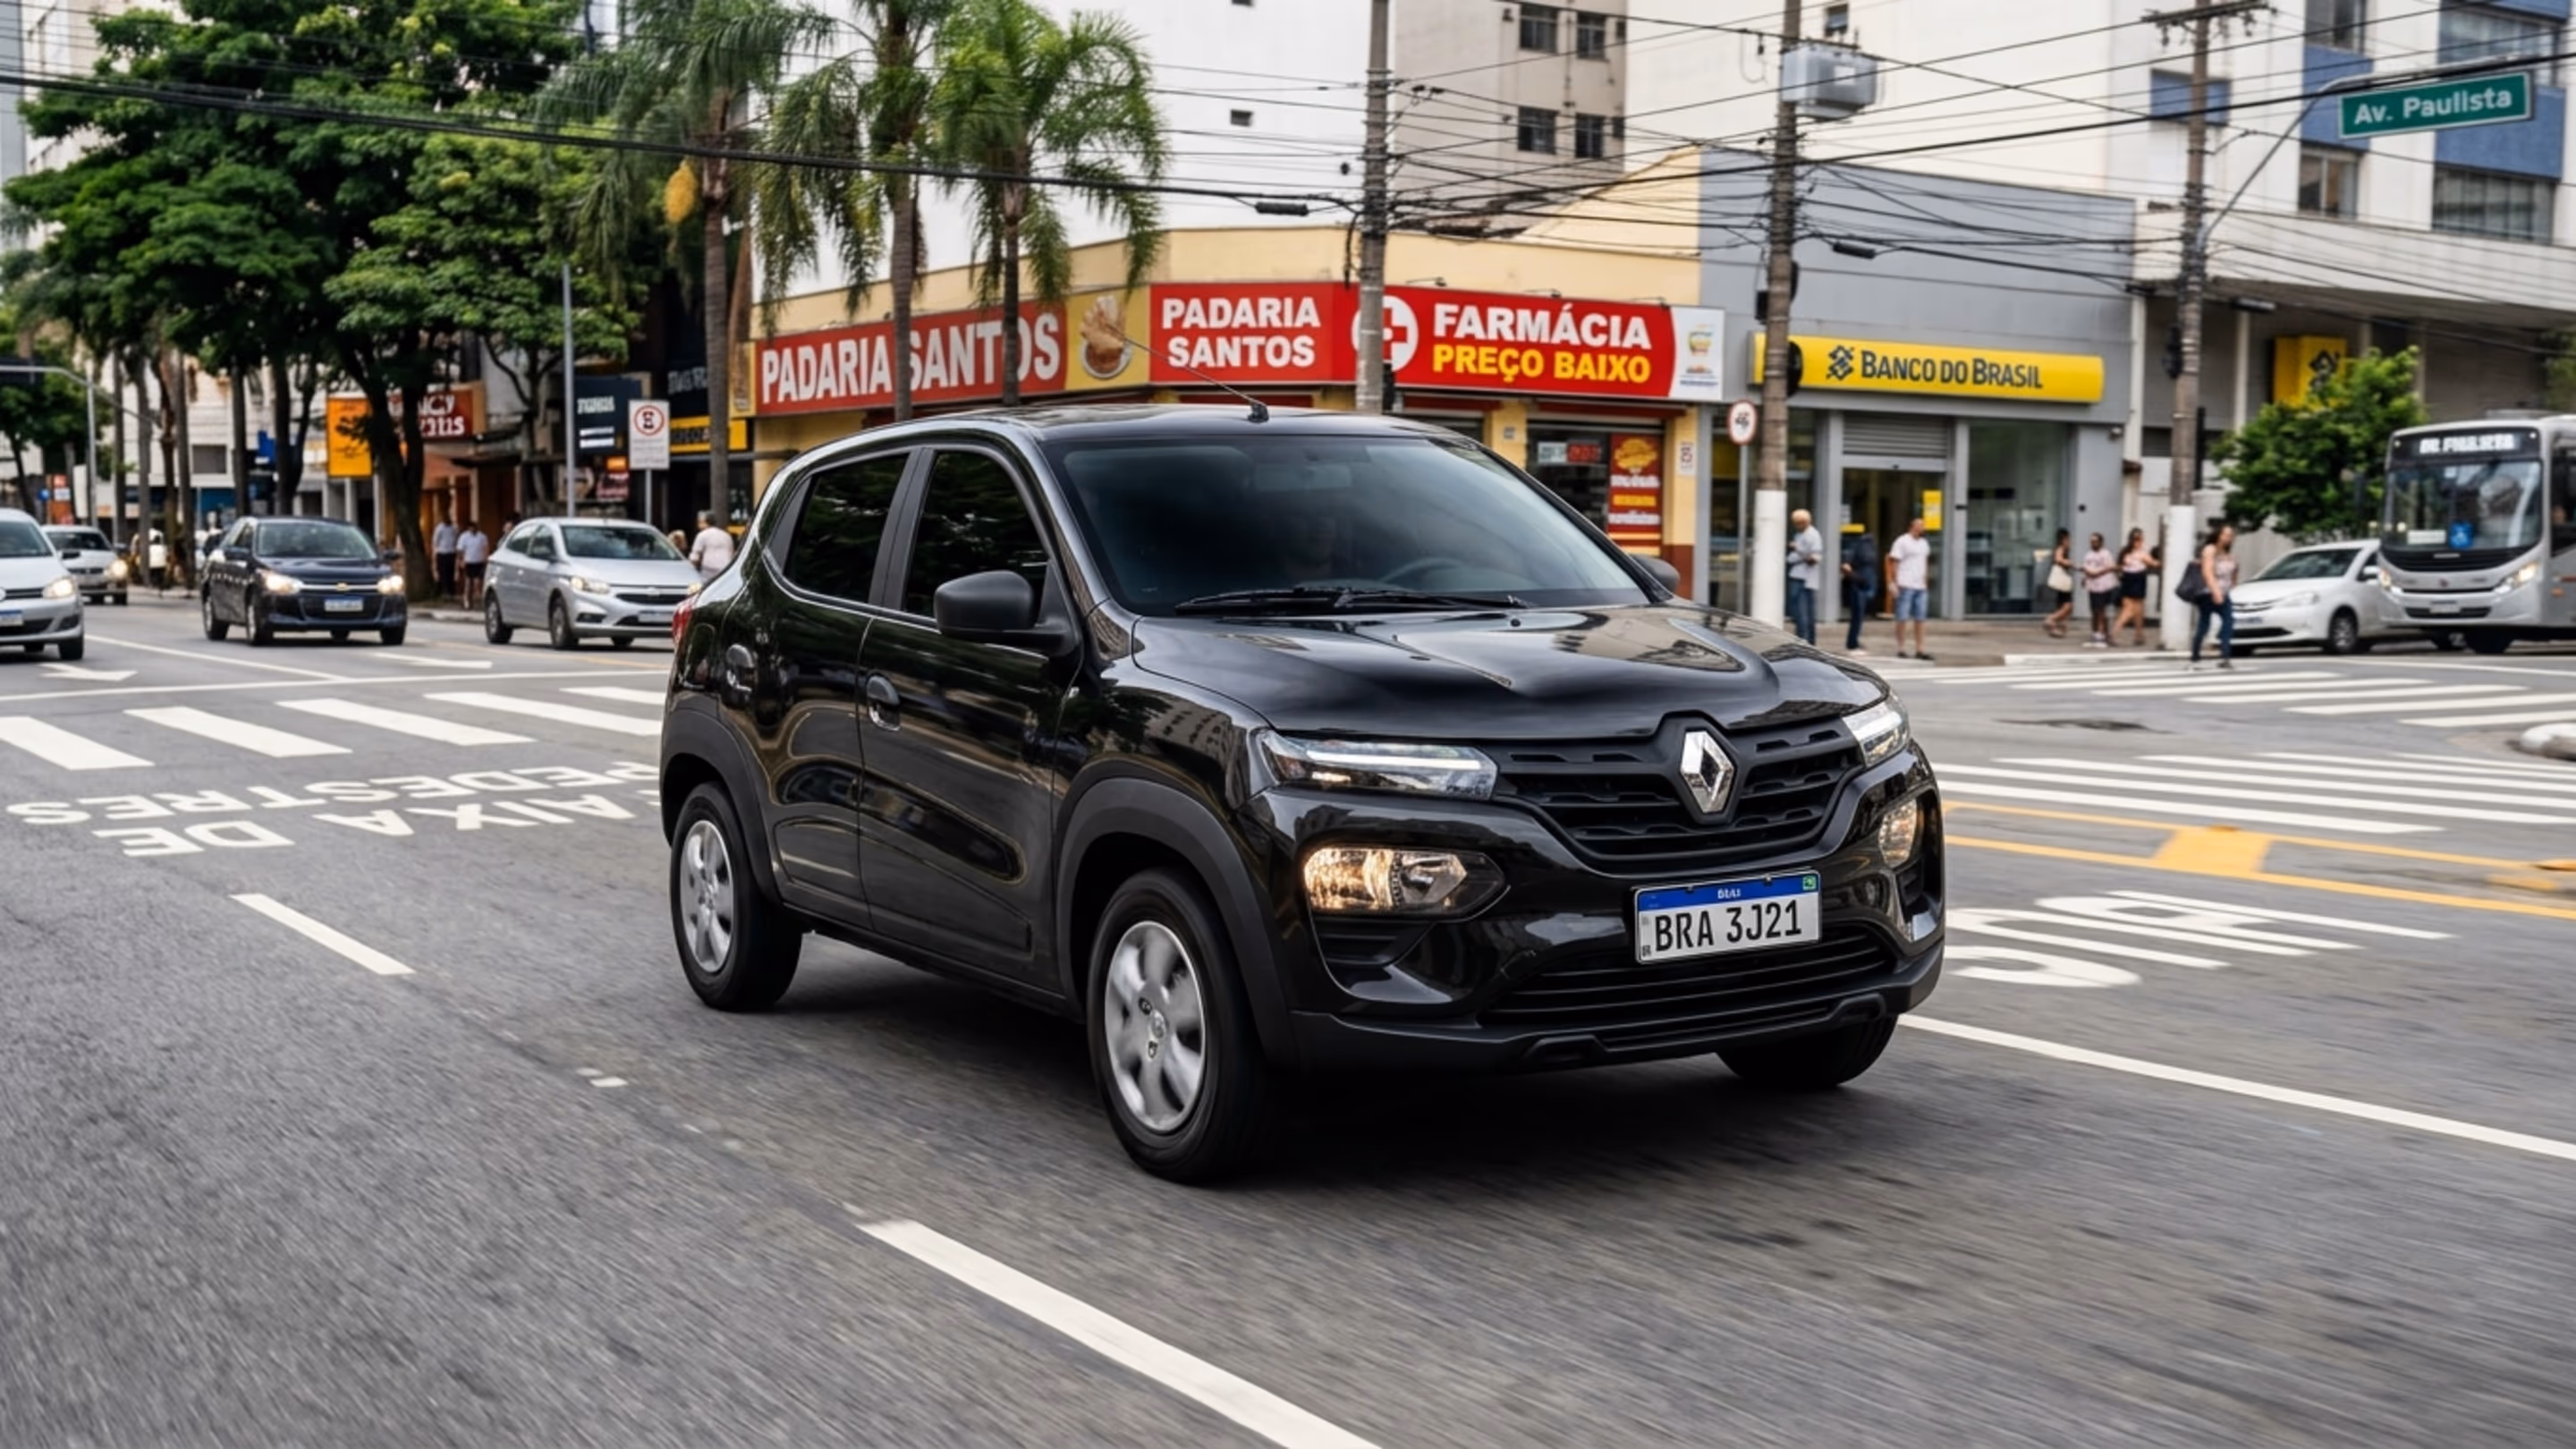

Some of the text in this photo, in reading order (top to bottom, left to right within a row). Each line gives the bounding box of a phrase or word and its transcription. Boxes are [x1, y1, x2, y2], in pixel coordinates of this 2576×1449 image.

[2354, 88, 2512, 124] Av. Paulista
[1162, 297, 1321, 329] PADARIA
[1434, 303, 1652, 350] FARMÁCIA
[762, 335, 893, 404] PADARIA
[1168, 335, 1316, 369] SANTOS
[1433, 343, 1544, 383] PREÇO
[1554, 351, 1652, 384] BAIXO
[1861, 350, 2043, 389] BANCO DO BRASIL
[91, 790, 661, 857] AIXA DE
[1655, 900, 1802, 952] BRA 3J21
